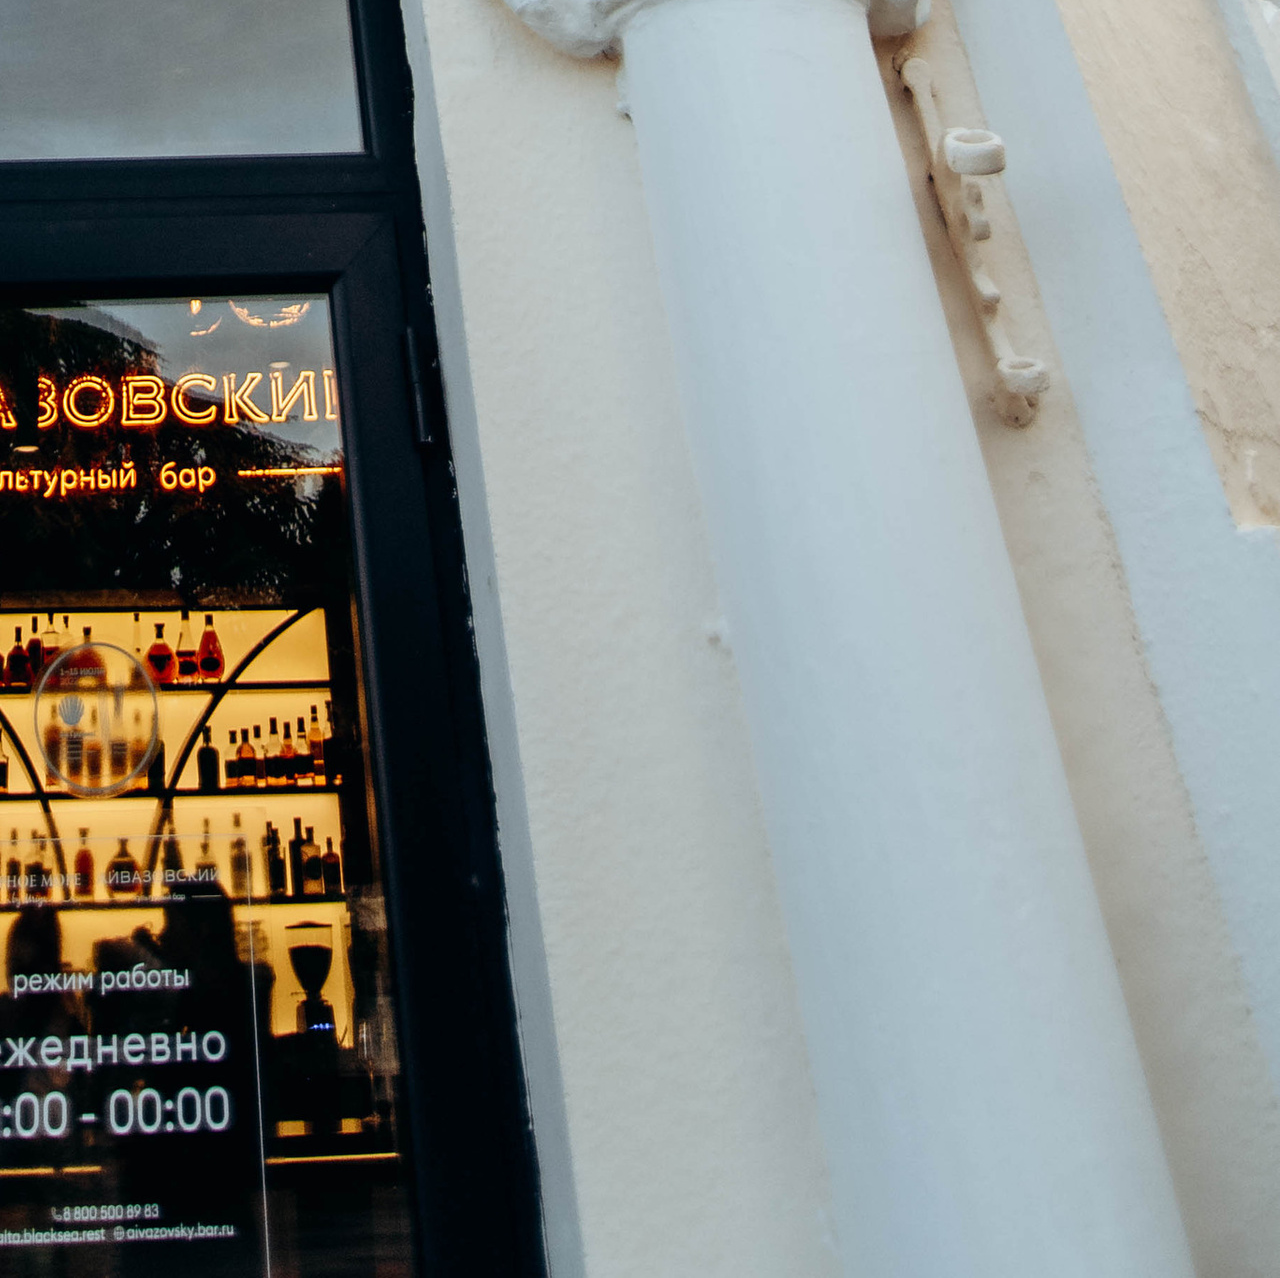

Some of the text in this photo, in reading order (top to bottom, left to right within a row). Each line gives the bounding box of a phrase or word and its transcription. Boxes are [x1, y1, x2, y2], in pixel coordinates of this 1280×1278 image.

[160, 460, 217, 494] бар
[13, 963, 190, 997] режим работы
[109, 1087, 231, 1135] 00:00
[73, 1205, 97, 1221] 800
[100, 1204, 124, 1220] 500
[126, 1204, 142, 1219] 89
[144, 1203, 160, 1218] 83
